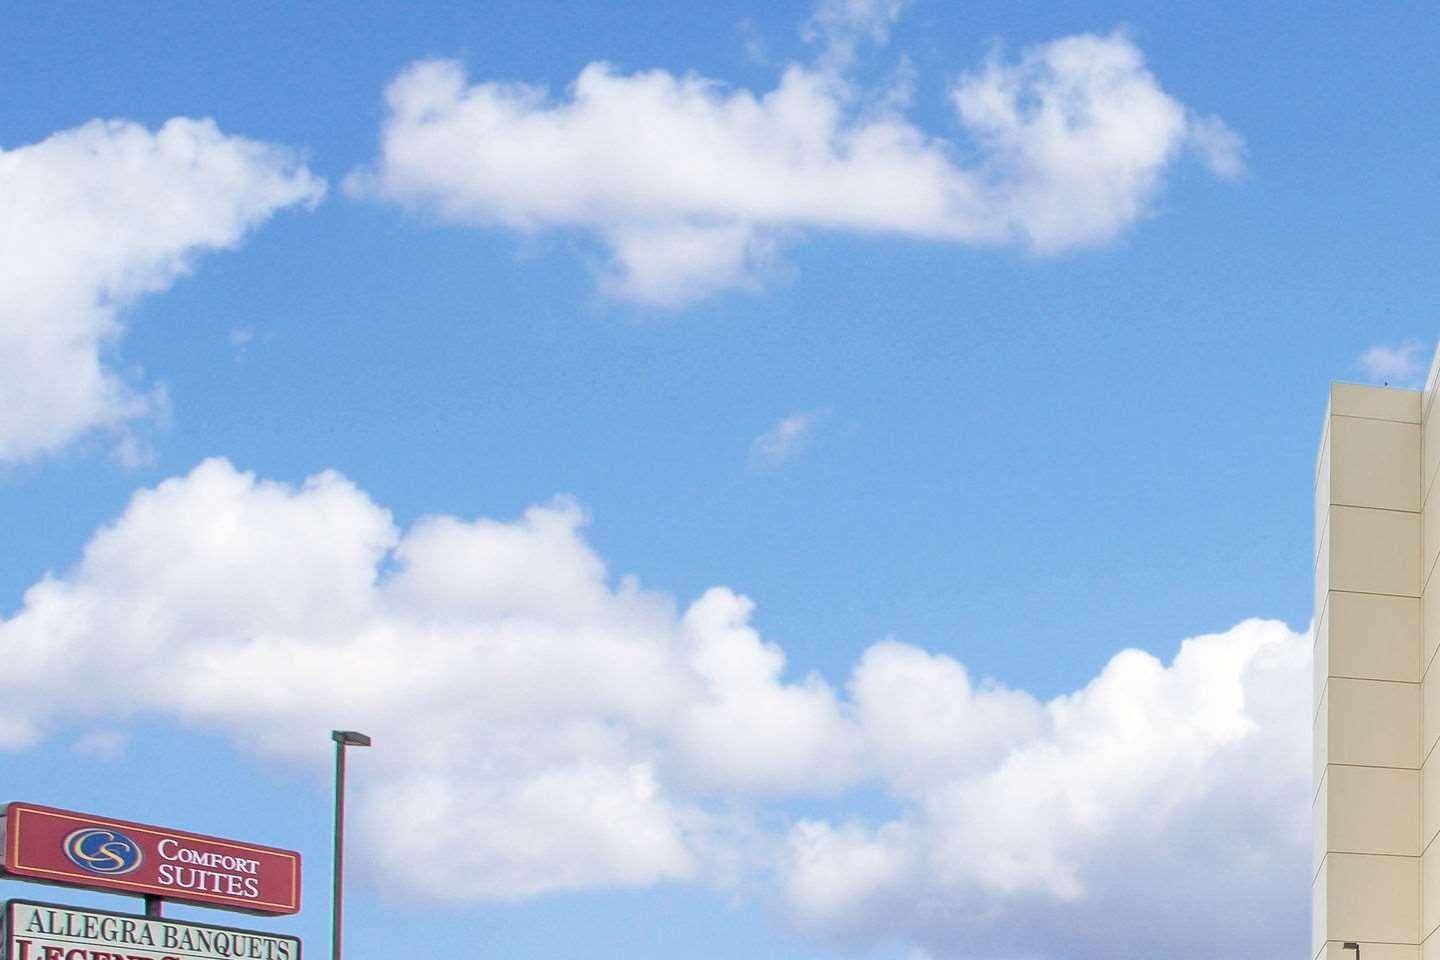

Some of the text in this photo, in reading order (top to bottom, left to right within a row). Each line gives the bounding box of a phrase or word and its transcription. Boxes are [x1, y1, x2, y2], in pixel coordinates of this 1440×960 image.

[158, 839, 261, 875] COMFORT
[158, 864, 260, 898] SUITES
[26, 909, 154, 946] ALLEGRA
